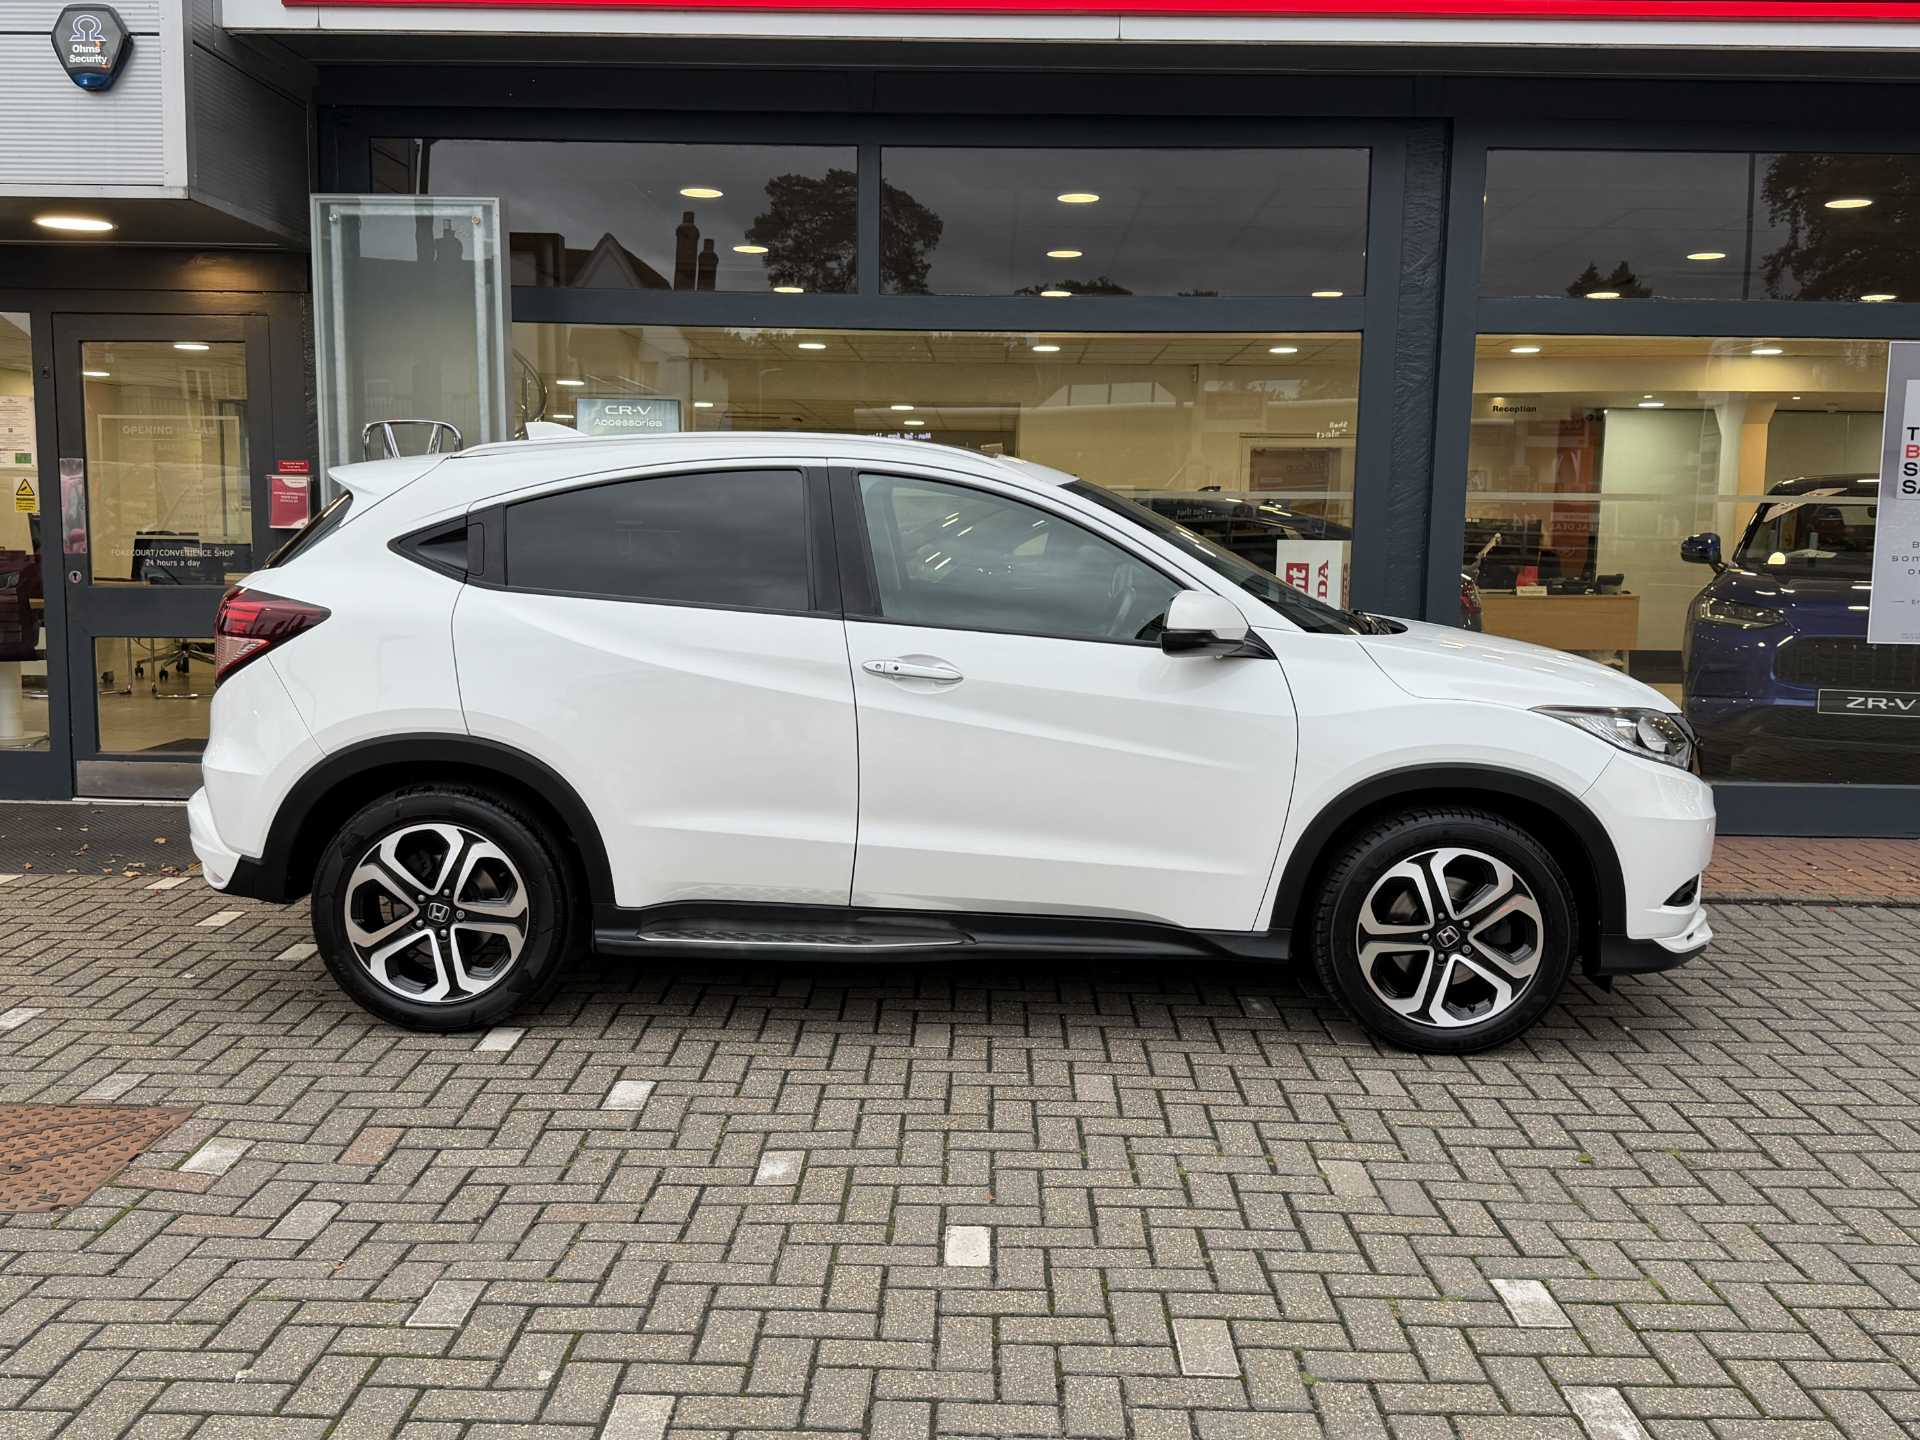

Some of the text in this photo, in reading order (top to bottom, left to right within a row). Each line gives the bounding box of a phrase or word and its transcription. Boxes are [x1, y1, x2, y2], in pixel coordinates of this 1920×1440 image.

[72, 45, 101, 53] Ohms
[69, 55, 107, 64] Security
[1492, 405, 1537, 413] Reception
[593, 418, 664, 427] Accessories
[122, 424, 173, 435] OPENING
[214, 549, 235, 558] SHOP
[145, 559, 154, 567] 24
[157, 559, 178, 567] hours
[187, 559, 201, 569] day
[1846, 696, 1917, 710] ZR-V
